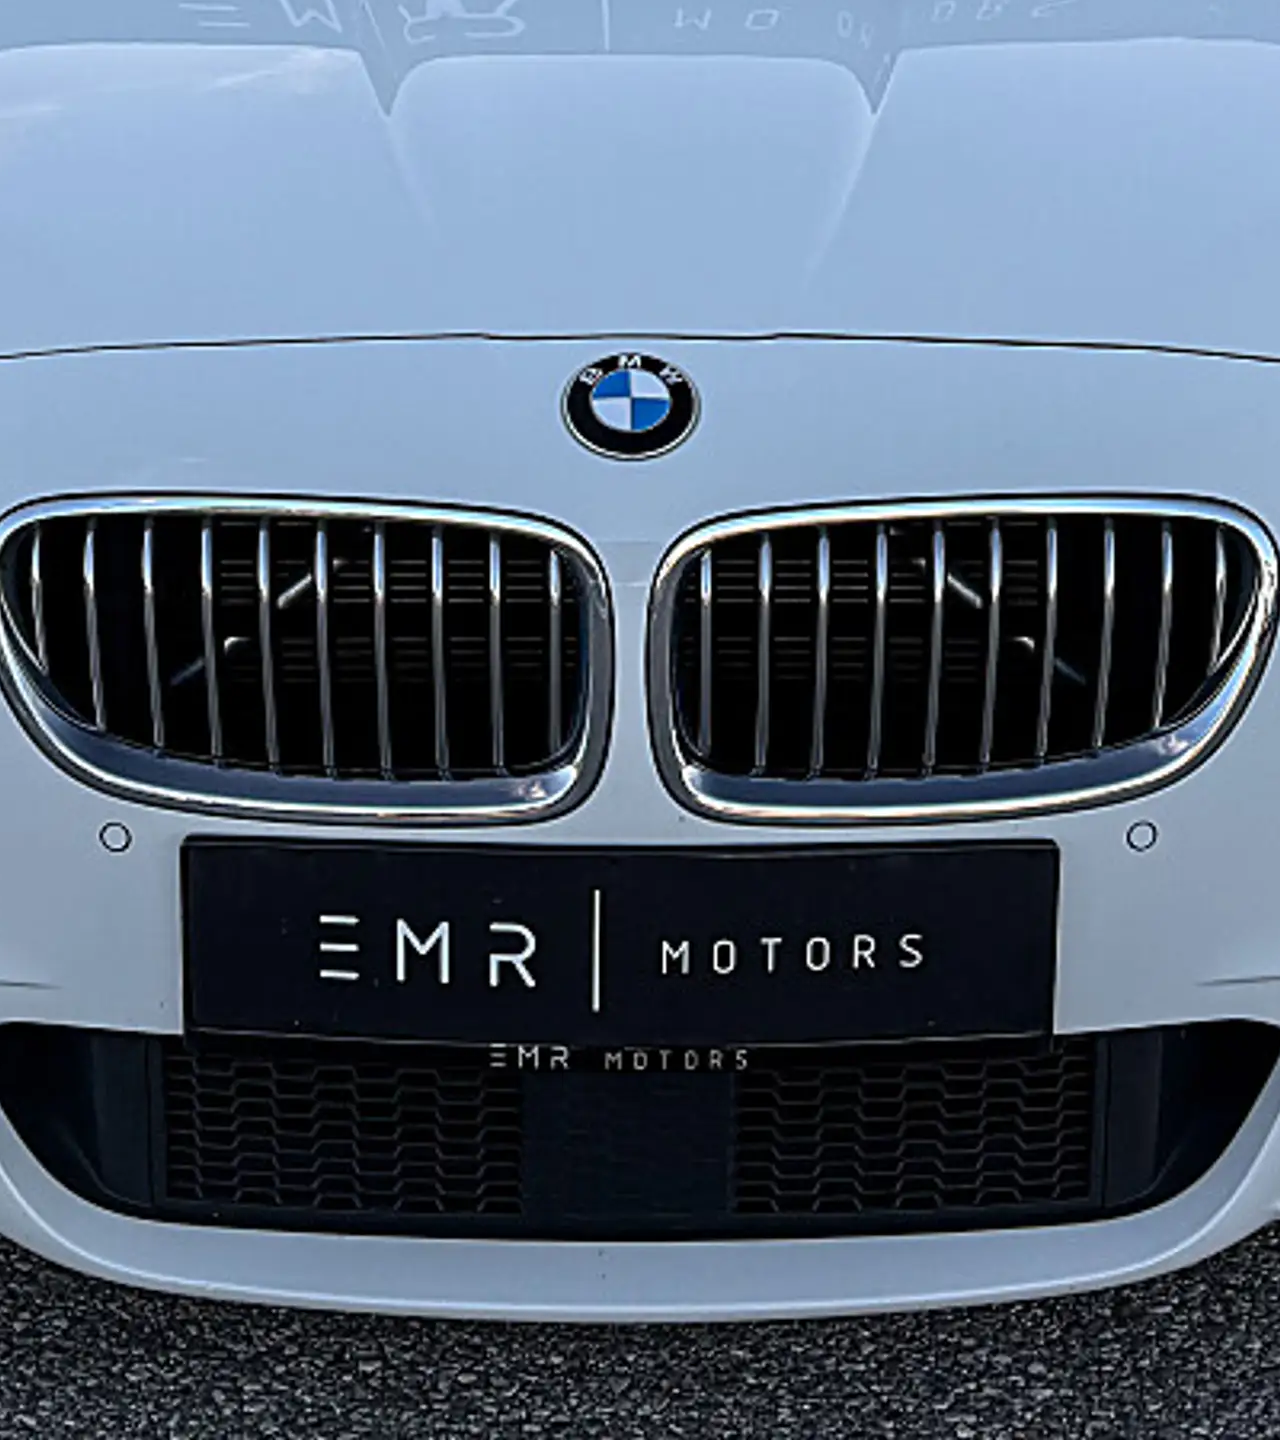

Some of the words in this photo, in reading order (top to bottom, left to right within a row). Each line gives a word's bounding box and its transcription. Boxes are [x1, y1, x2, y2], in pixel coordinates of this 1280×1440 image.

[579, 354, 683, 386] BMW
[319, 913, 538, 989] EMR
[660, 932, 925, 976] MOTORS
[489, 1043, 570, 1070] EMR
[604, 1048, 749, 1071] MOTORS
